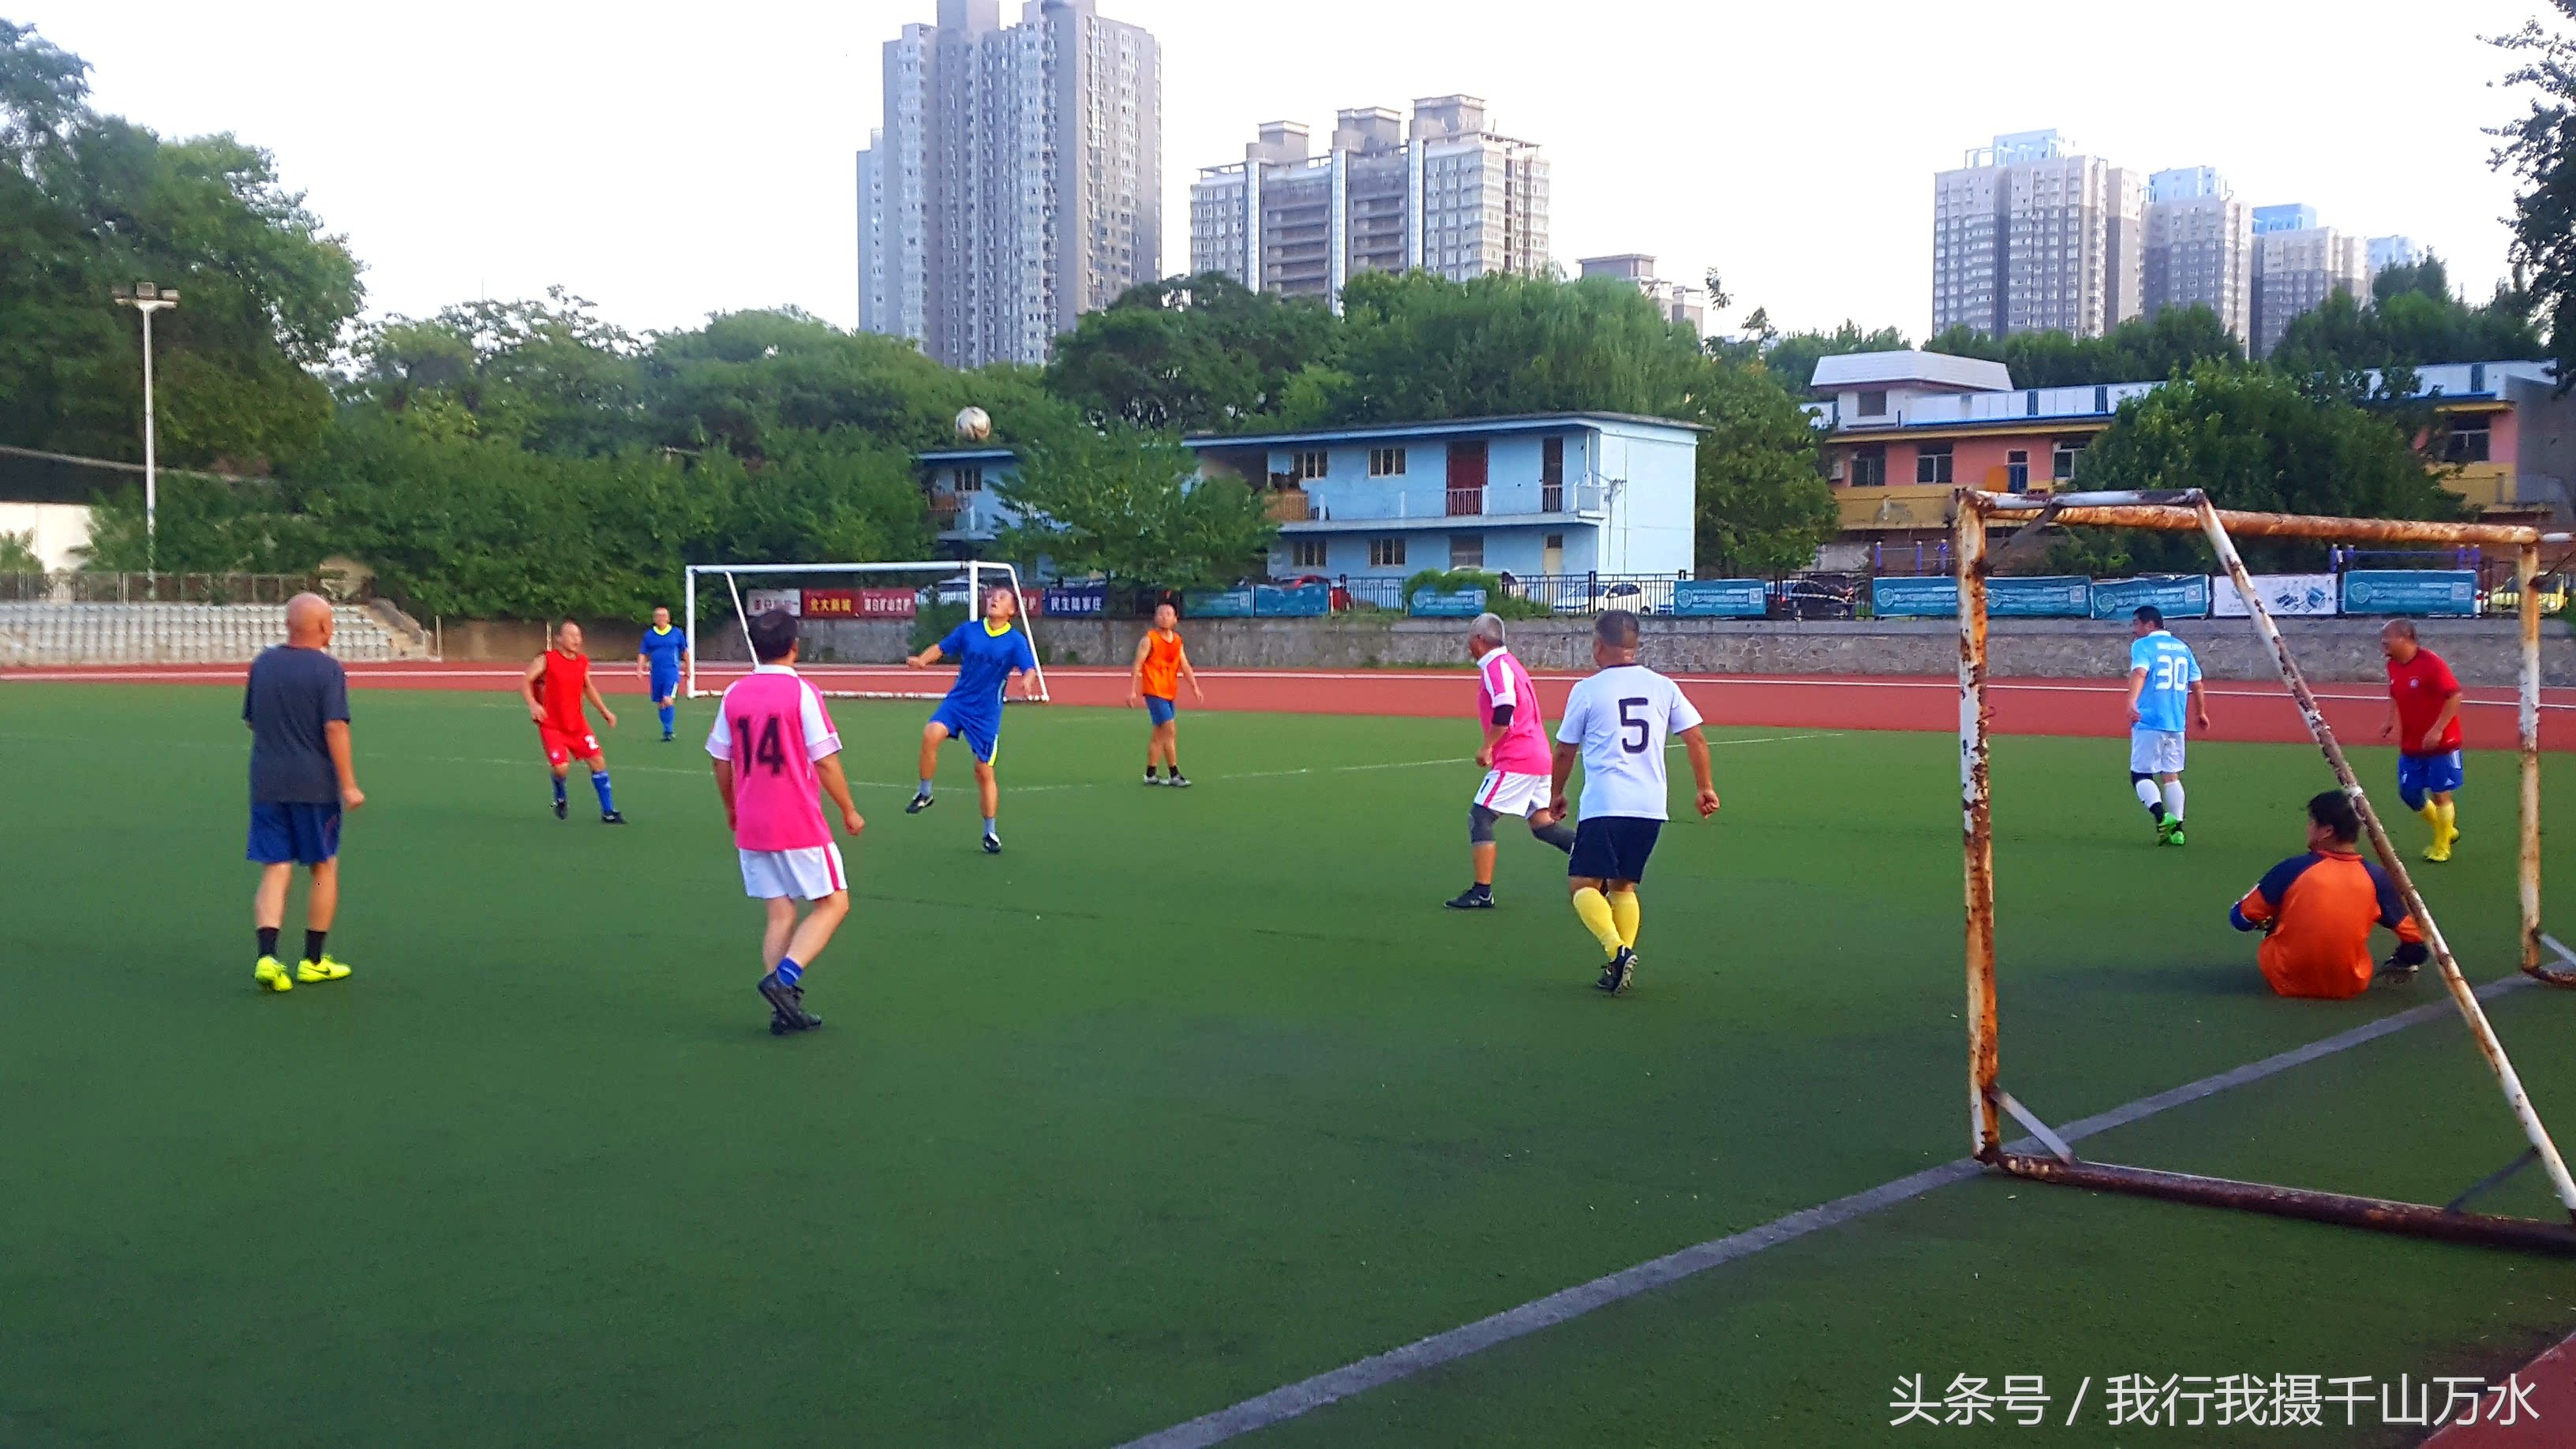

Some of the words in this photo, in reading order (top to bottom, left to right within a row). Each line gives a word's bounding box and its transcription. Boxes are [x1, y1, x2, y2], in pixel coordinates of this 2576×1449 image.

[2155, 655, 2188, 691] 30
[738, 717, 784, 774] 14
[1618, 698, 1649, 753] 5
